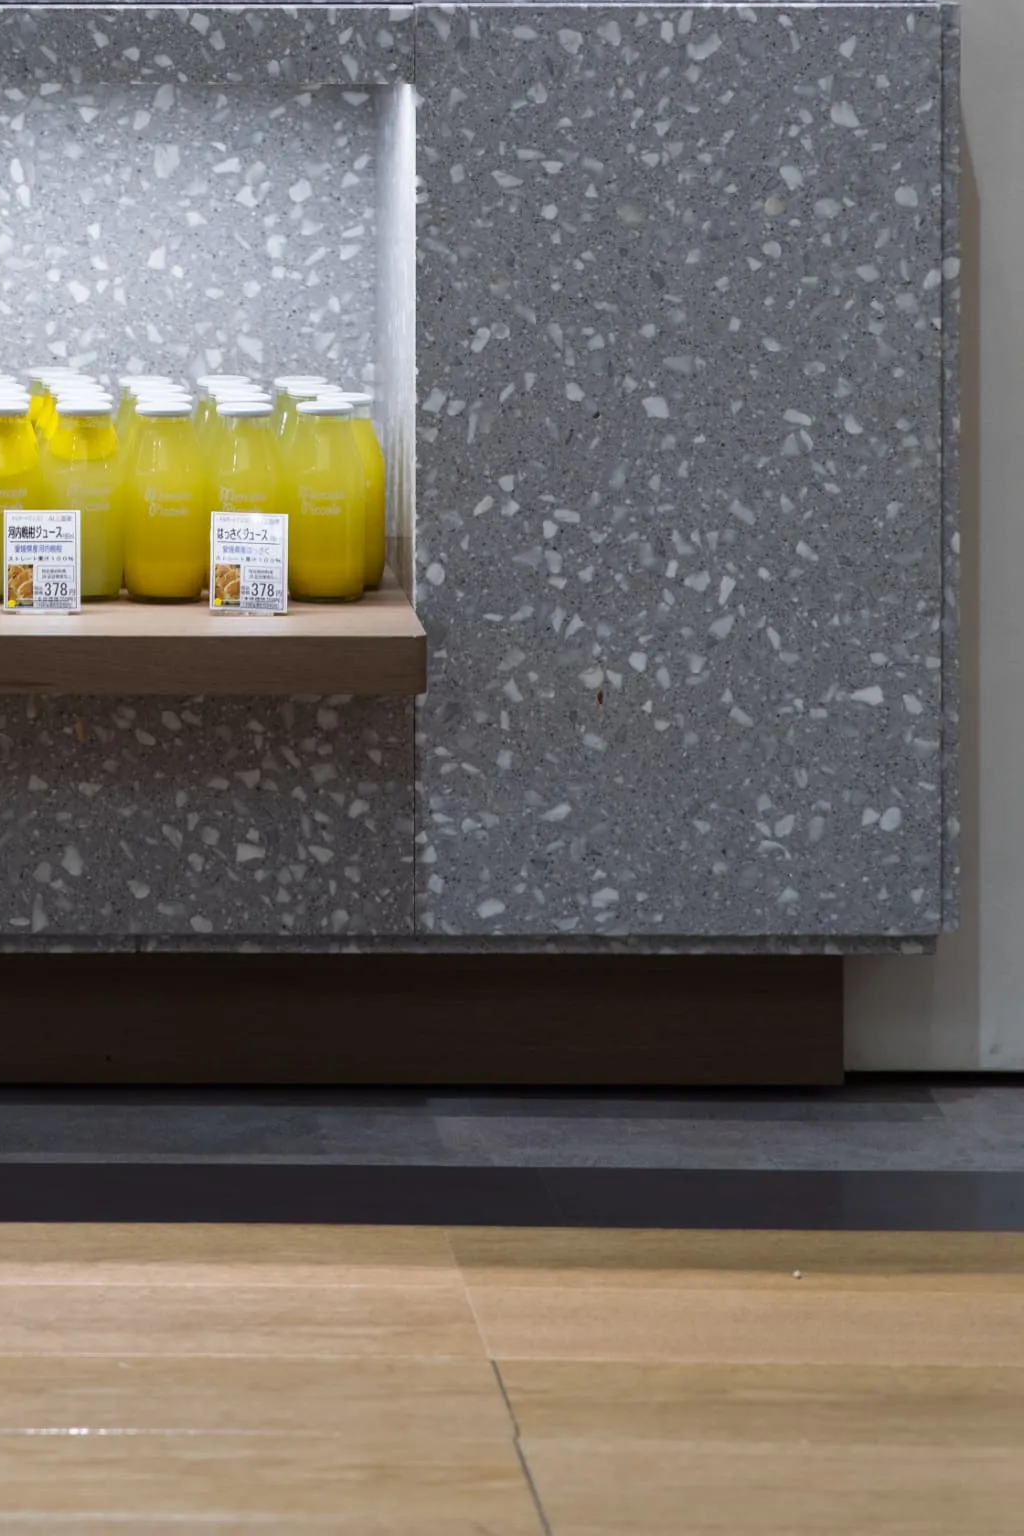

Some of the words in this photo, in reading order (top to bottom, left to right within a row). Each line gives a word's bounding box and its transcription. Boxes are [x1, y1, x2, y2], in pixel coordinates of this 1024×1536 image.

[8, 526, 62, 539] 河内晩柑ジュース
[217, 528, 268, 541] はっさくジュース
